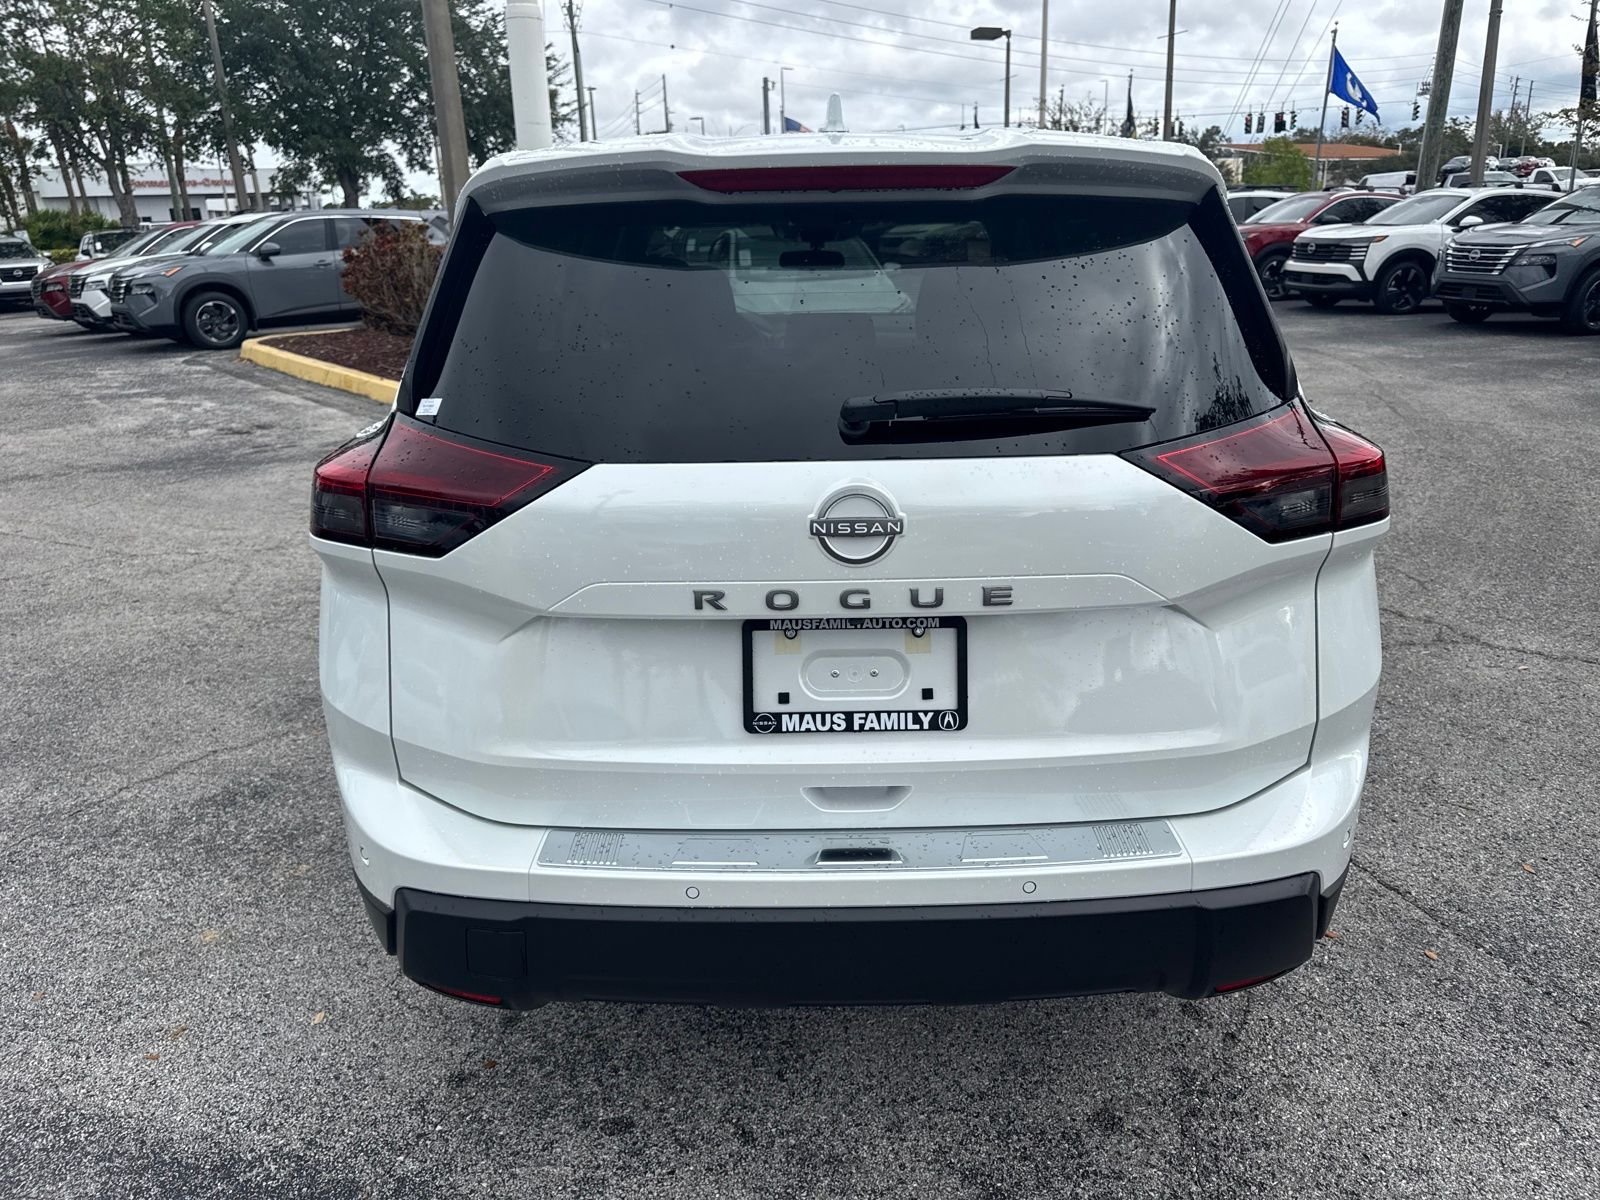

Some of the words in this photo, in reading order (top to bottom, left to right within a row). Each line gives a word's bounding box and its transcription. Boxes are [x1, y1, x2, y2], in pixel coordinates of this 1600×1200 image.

[811, 521, 901, 535] NISSAN
[692, 585, 1014, 611] ROGUE
[780, 713, 847, 732] MAUS
[852, 711, 934, 731] FAMILY
